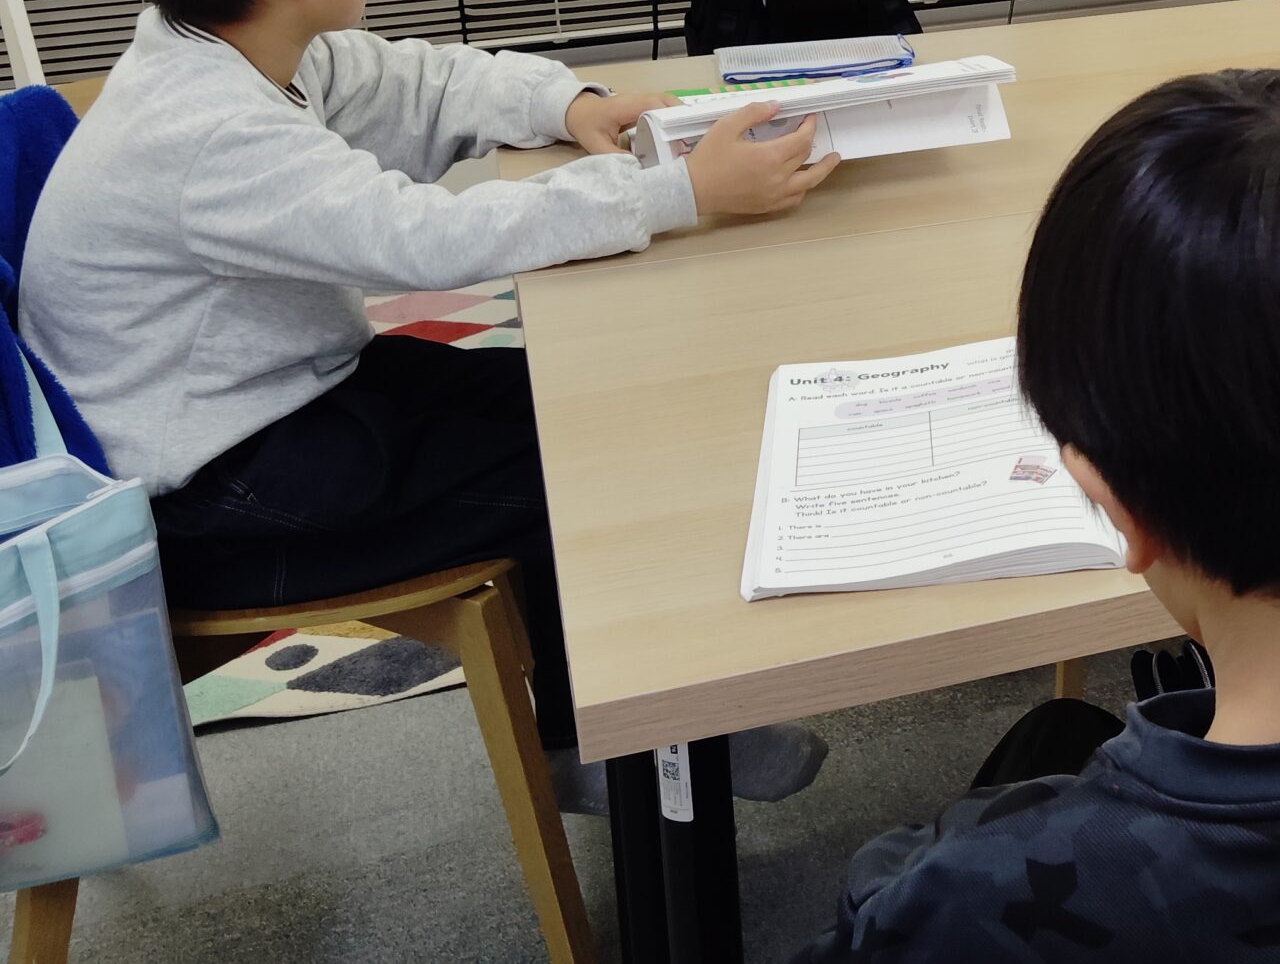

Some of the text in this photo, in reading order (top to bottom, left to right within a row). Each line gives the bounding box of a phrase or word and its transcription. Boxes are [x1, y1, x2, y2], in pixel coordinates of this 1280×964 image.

[790, 377, 832, 386] Unit
[857, 362, 949, 380] Geography
[911, 378, 952, 388] countable
[846, 422, 884, 431] countable
[896, 481, 918, 490] your
[921, 470, 961, 484] kitchen?
[851, 500, 898, 512] countable
[914, 480, 988, 502] non-countable?
